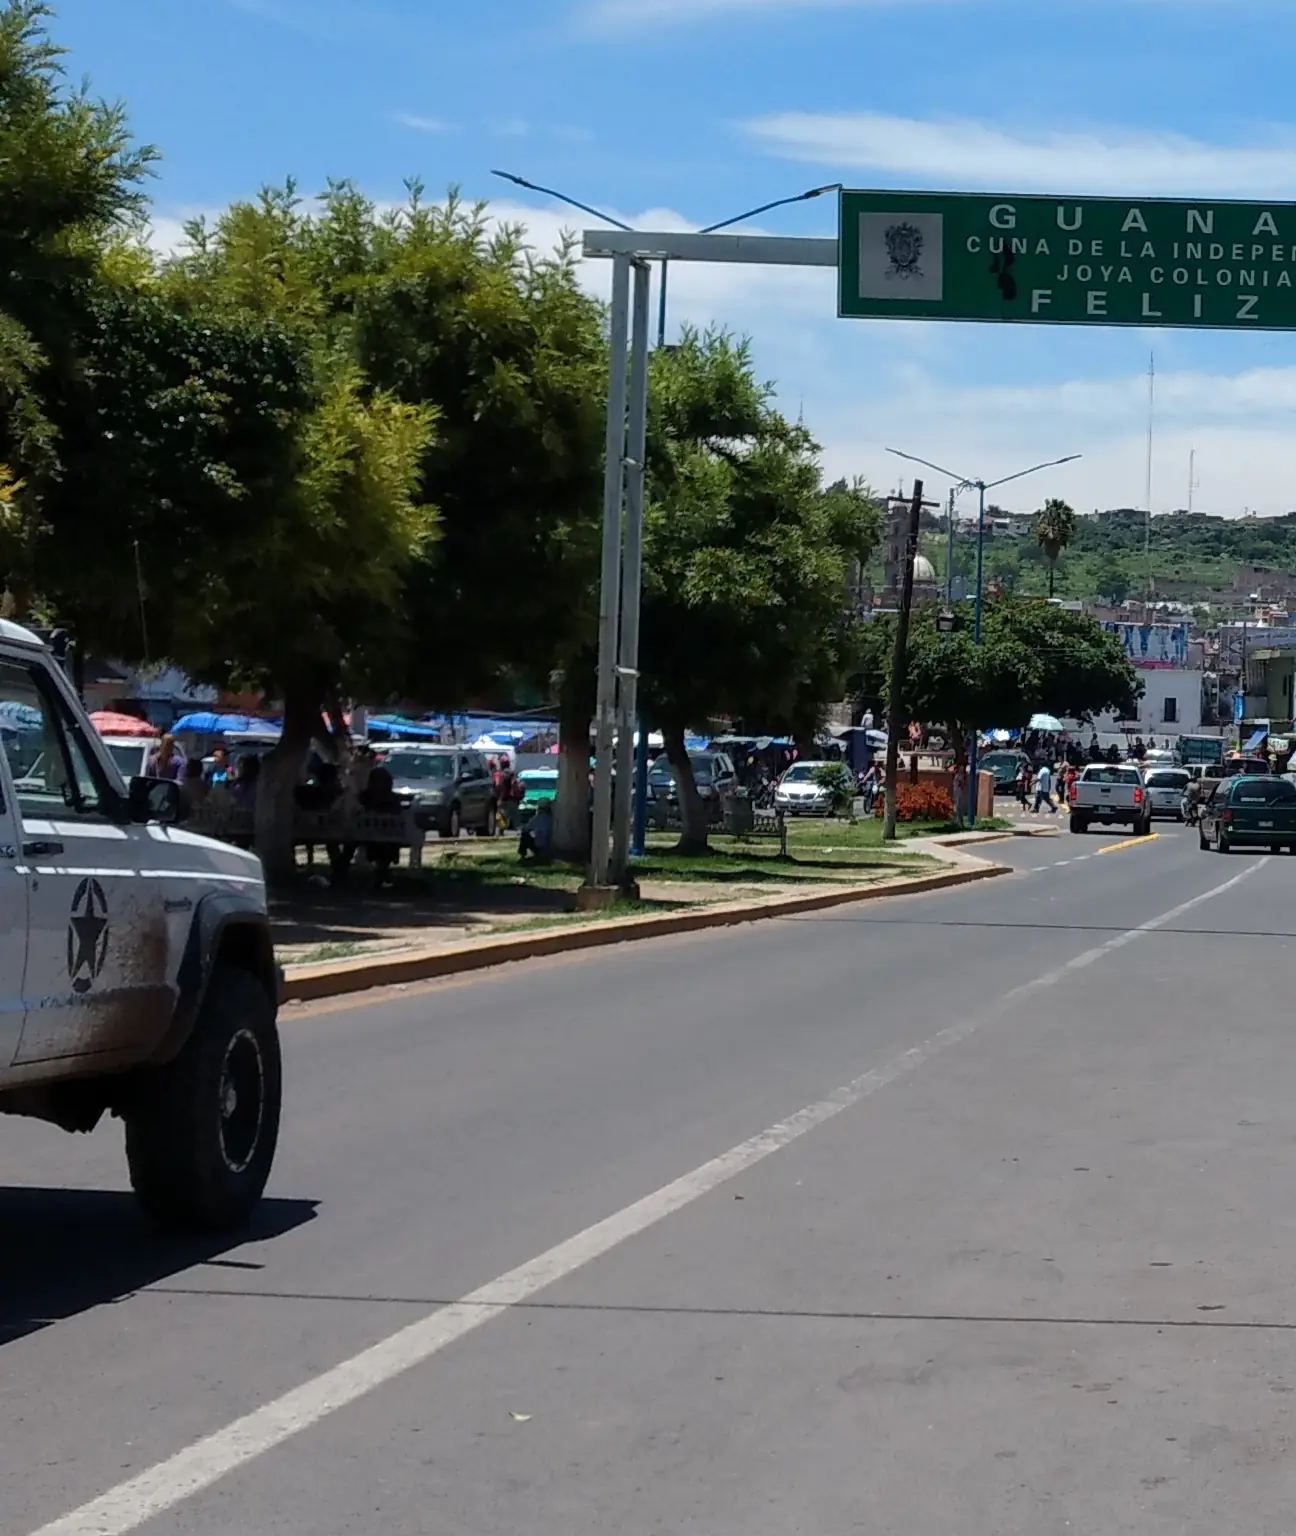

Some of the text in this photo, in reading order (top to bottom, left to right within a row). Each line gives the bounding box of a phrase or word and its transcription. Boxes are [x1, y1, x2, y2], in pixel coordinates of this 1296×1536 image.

[966, 235, 1050, 255] CUNA
[1068, 239, 1104, 256] DE
[1120, 241, 1156, 259] LA
[1056, 265, 1133, 283] JOYA
[1031, 289, 1260, 320] FELIZ
